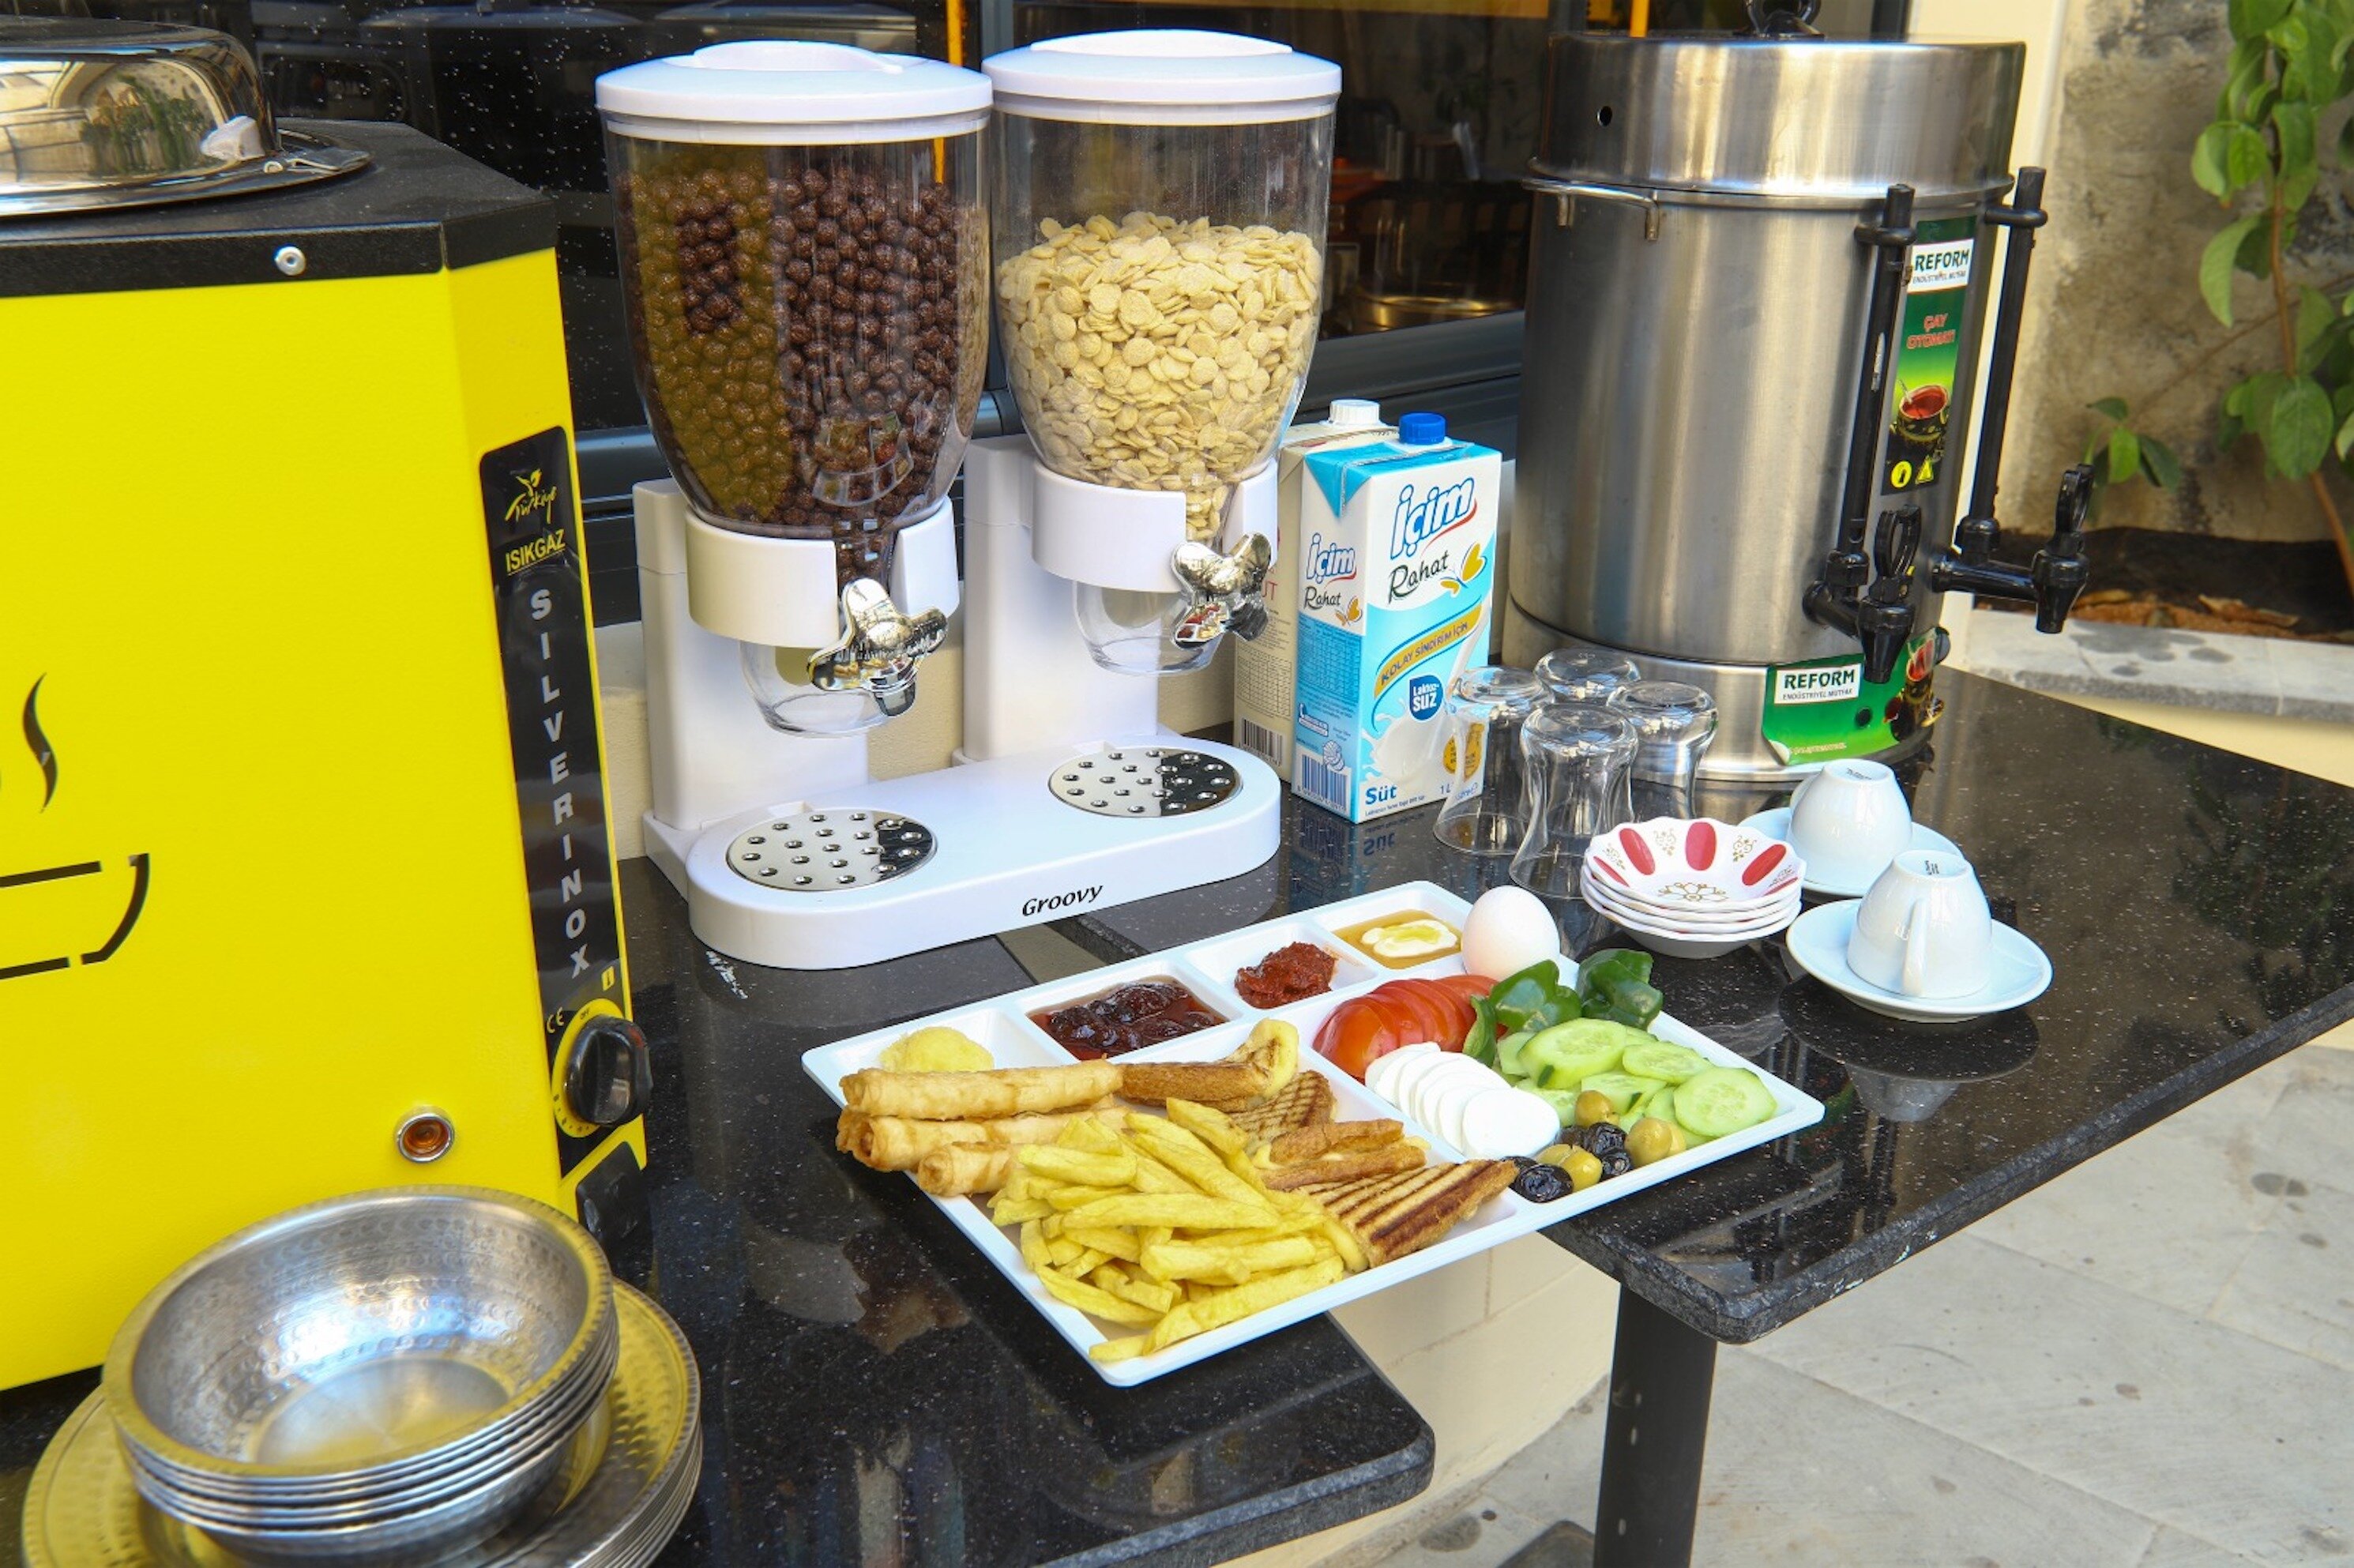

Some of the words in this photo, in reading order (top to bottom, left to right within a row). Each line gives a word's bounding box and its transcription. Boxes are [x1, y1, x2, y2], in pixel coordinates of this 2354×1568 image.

[1915, 249, 1969, 272] REFORM
[506, 528, 566, 573] ISIKGAZ
[1389, 550, 1450, 604] Rahat
[1303, 585, 1341, 610] Rahat
[1381, 652, 1413, 686] KOLAY
[1784, 669, 1855, 690] REFORM
[1412, 693, 1437, 713] SUZ
[530, 588, 591, 979] SILVERINOX
[1365, 784, 1397, 805] Süt
[1022, 885, 1104, 916] Groovy
